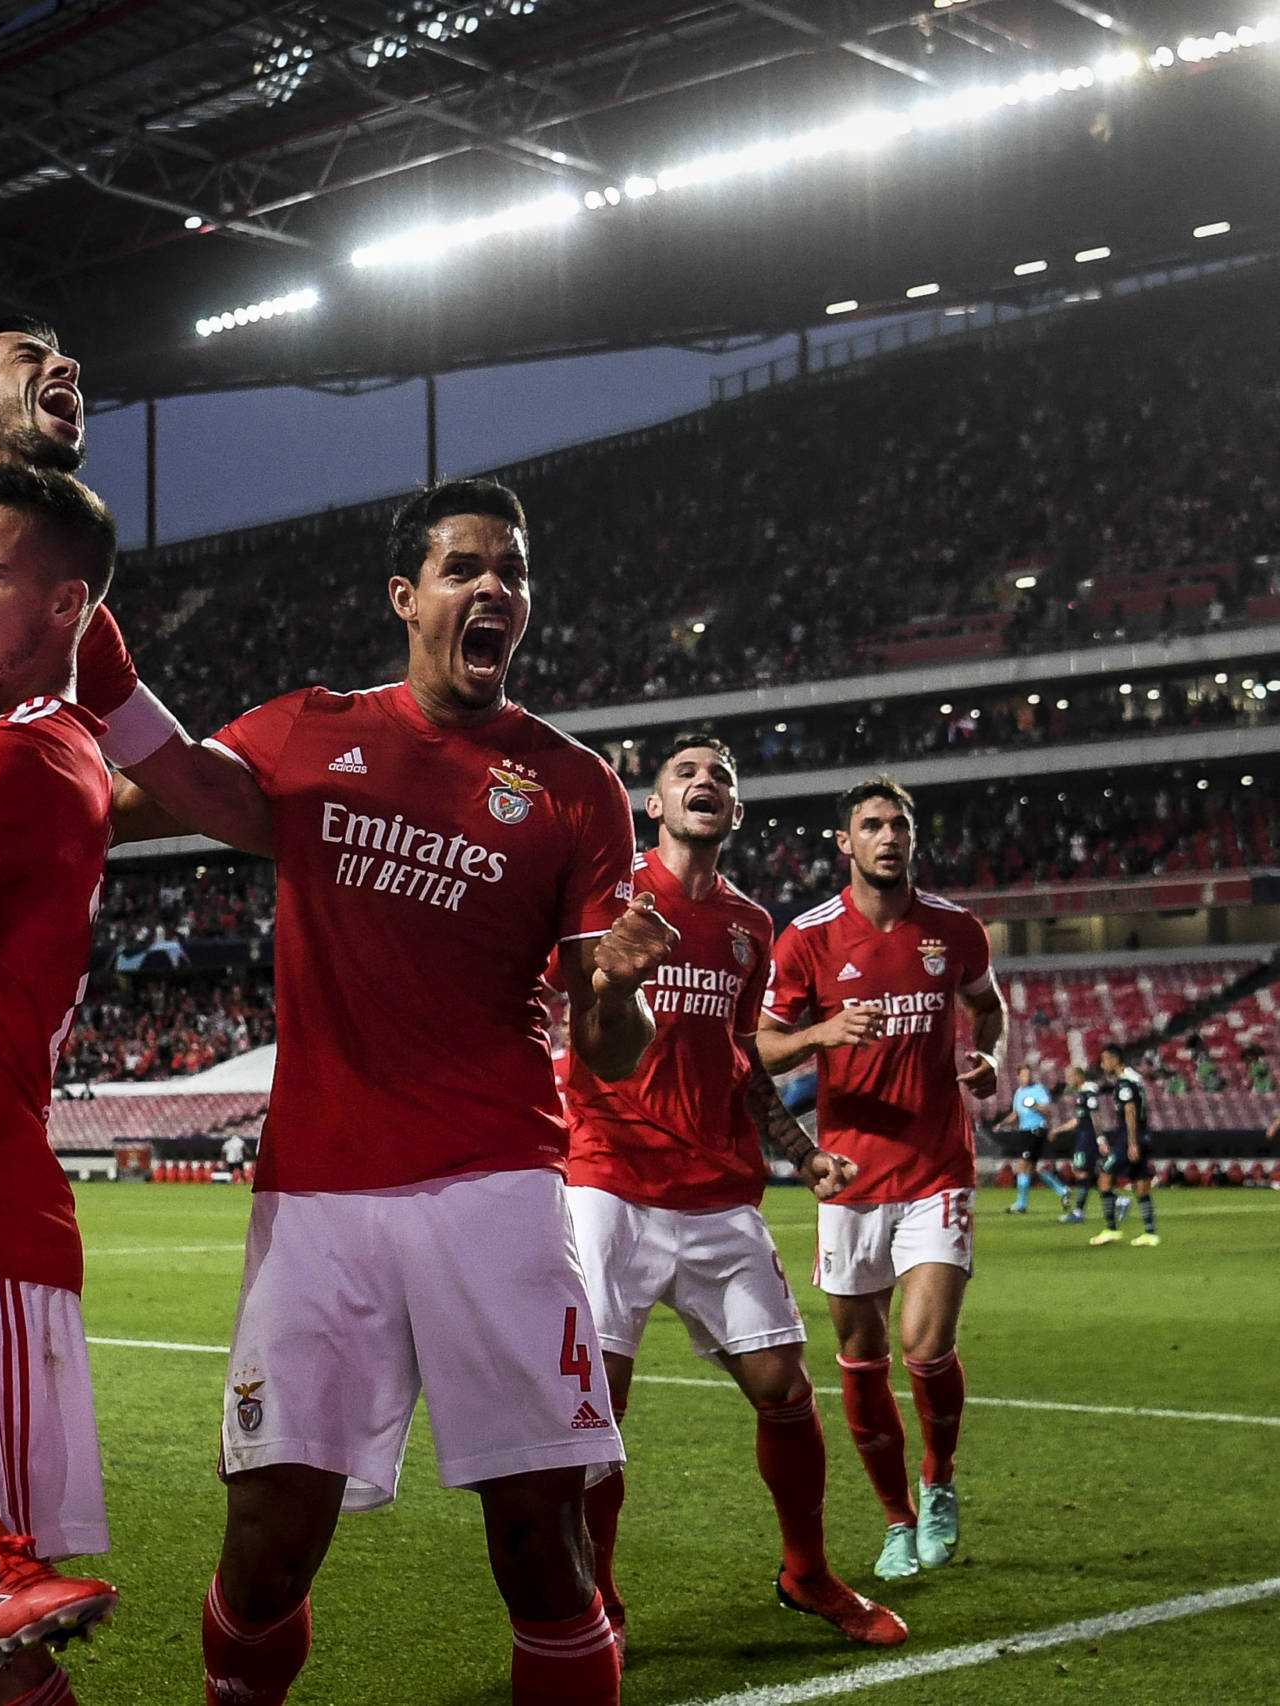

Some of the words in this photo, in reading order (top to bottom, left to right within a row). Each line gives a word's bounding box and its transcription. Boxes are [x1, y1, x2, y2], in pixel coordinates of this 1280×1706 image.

[328, 761, 368, 775] adidas
[322, 802, 507, 883] Emirates
[336, 853, 374, 887] FLY
[373, 860, 468, 912] BETTER
[640, 962, 742, 997] mirates
[654, 989, 680, 1012] FLY
[886, 1014, 933, 1037] BETTER
[560, 1306, 592, 1393] 4
[571, 1417, 610, 1430] adidas
